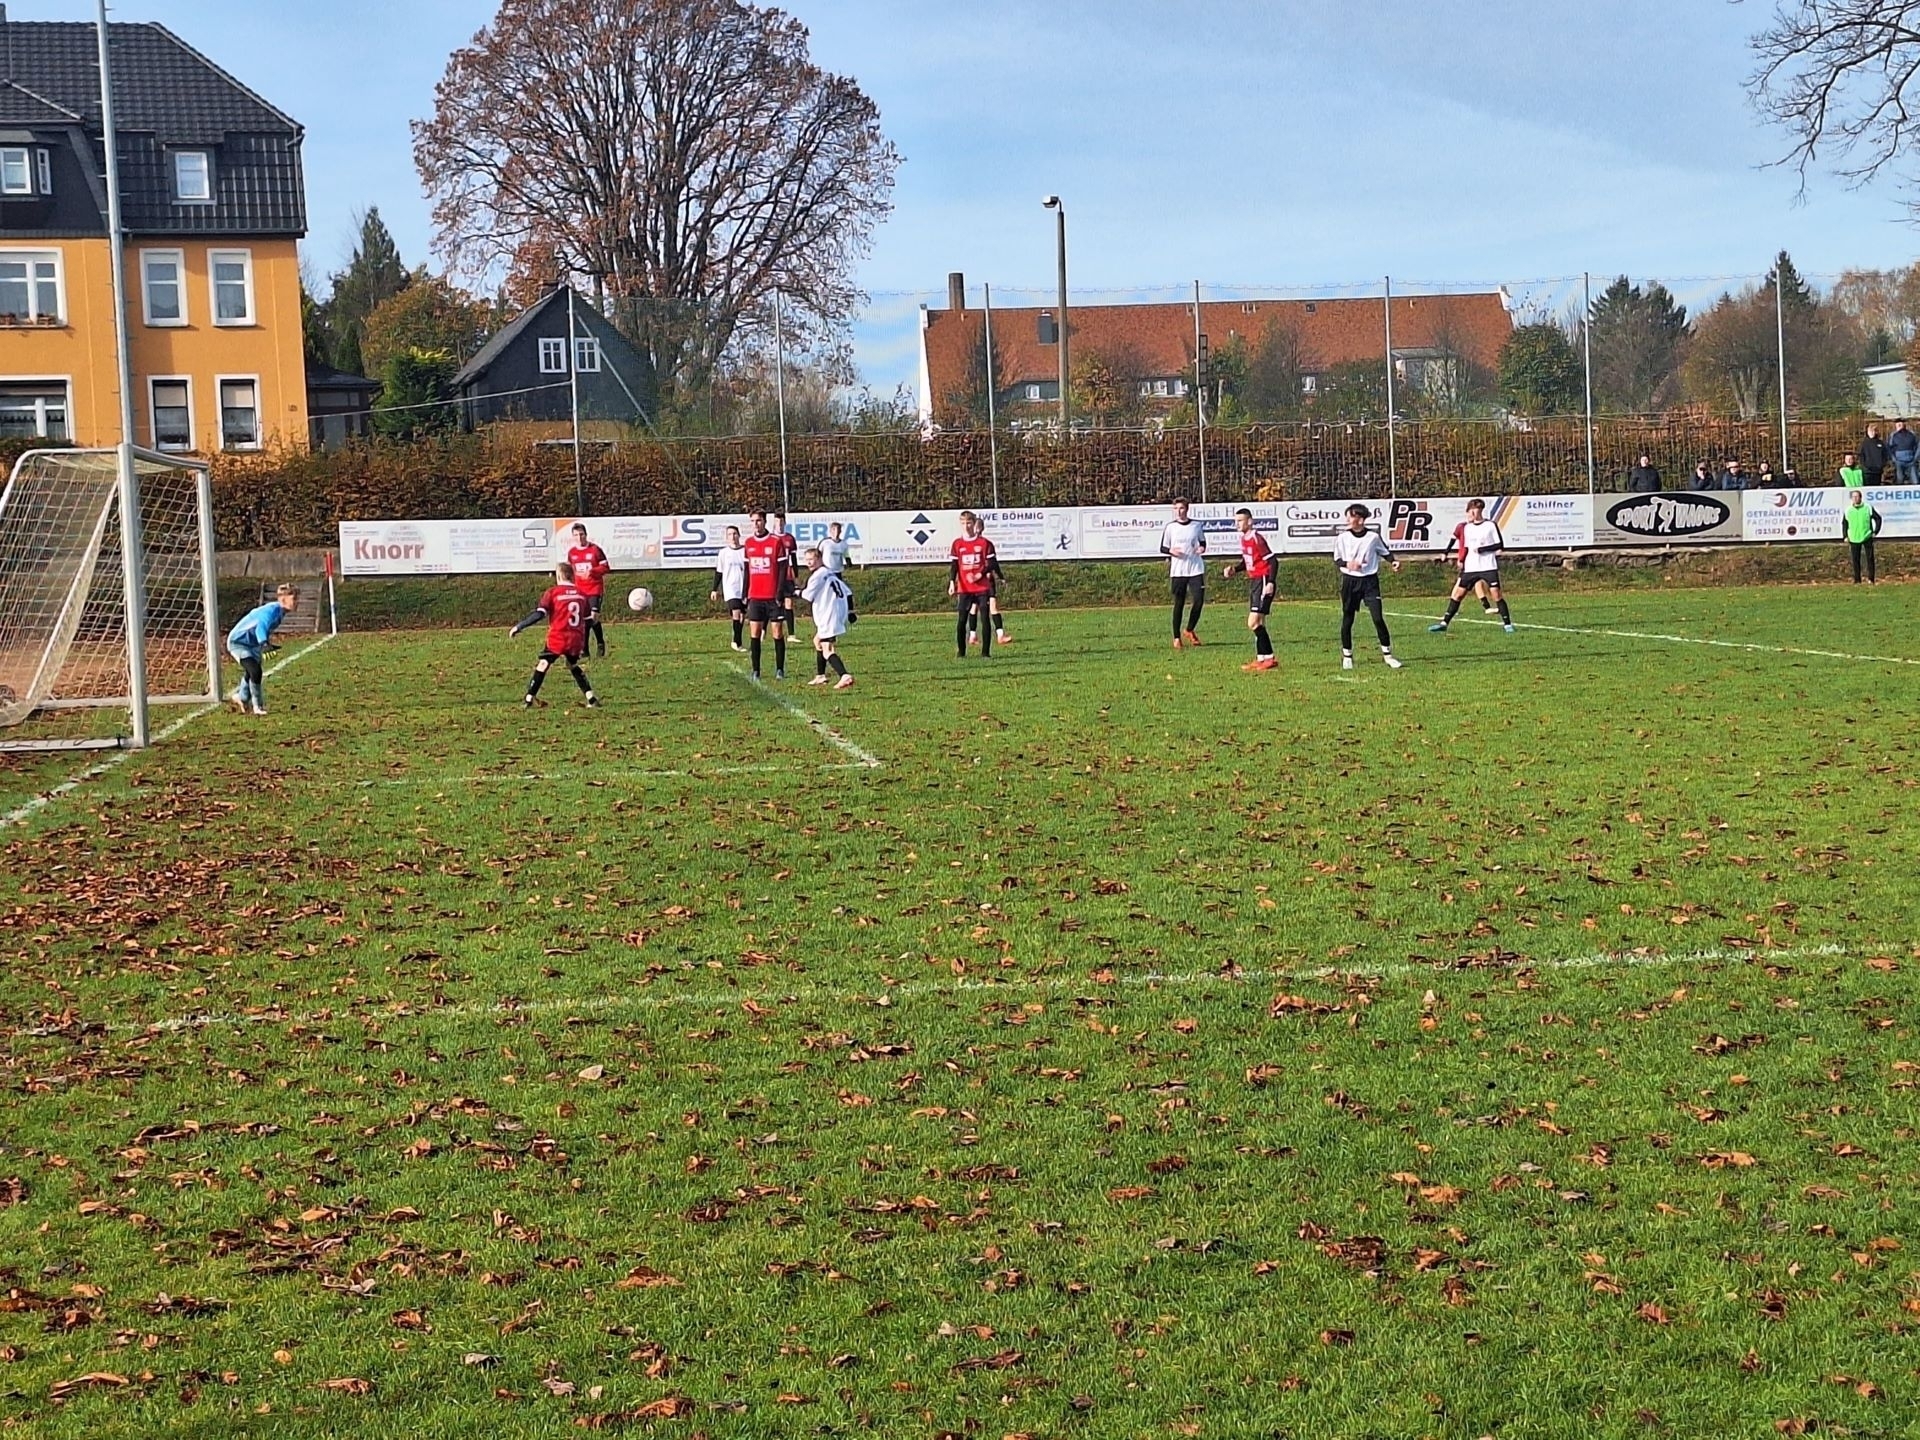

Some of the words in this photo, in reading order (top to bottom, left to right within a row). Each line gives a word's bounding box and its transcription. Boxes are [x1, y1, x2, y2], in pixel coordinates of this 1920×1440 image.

[1526, 501, 1575, 509] Schiffner
[1789, 491, 1824, 507] WM
[1002, 511, 1044, 521] BÖHMIG
[1190, 506, 1220, 518] lrich
[1225, 505, 1277, 517] Hmel
[1286, 505, 1340, 520] Gastro
[1616, 504, 1657, 530] SPORT
[785, 523, 860, 541] ERA
[354, 539, 424, 560] Knorr
[567, 601, 580, 627] 3
